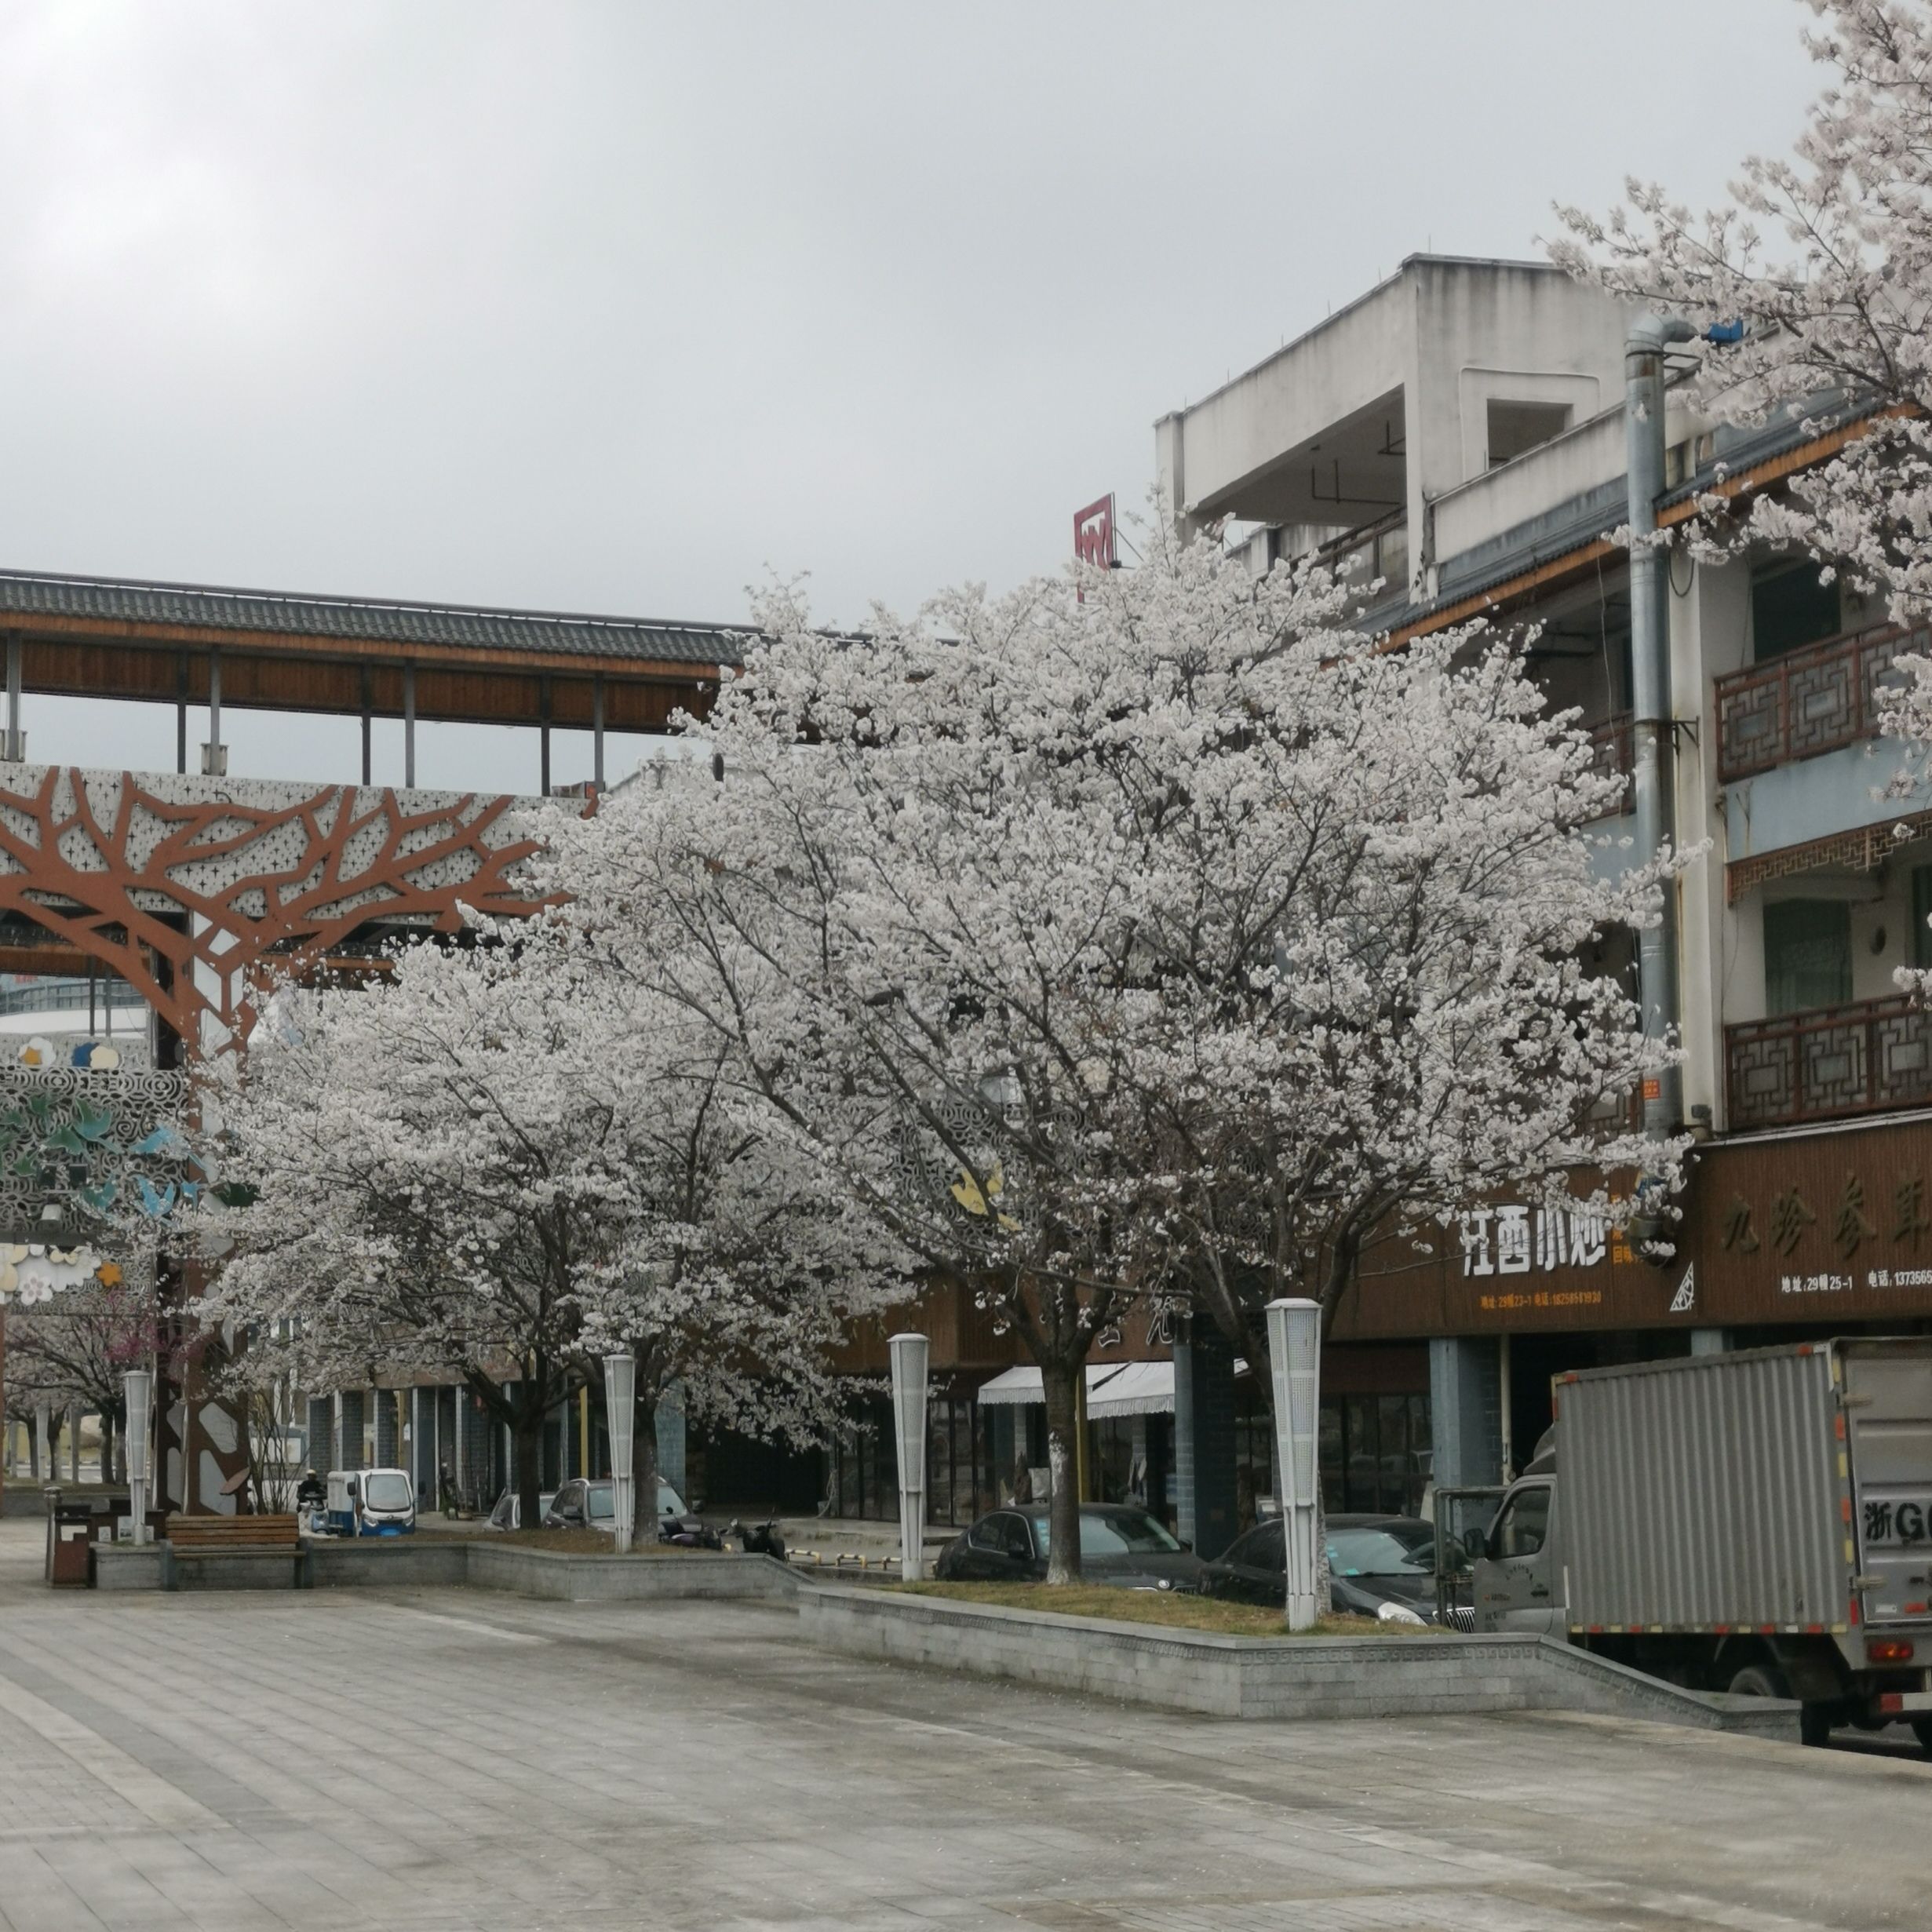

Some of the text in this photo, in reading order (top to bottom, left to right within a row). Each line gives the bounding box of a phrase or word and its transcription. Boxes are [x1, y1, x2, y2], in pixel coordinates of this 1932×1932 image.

[1460, 1205, 1606, 1276] 江西小炒
[1865, 1502, 1932, 1540] 浙G
